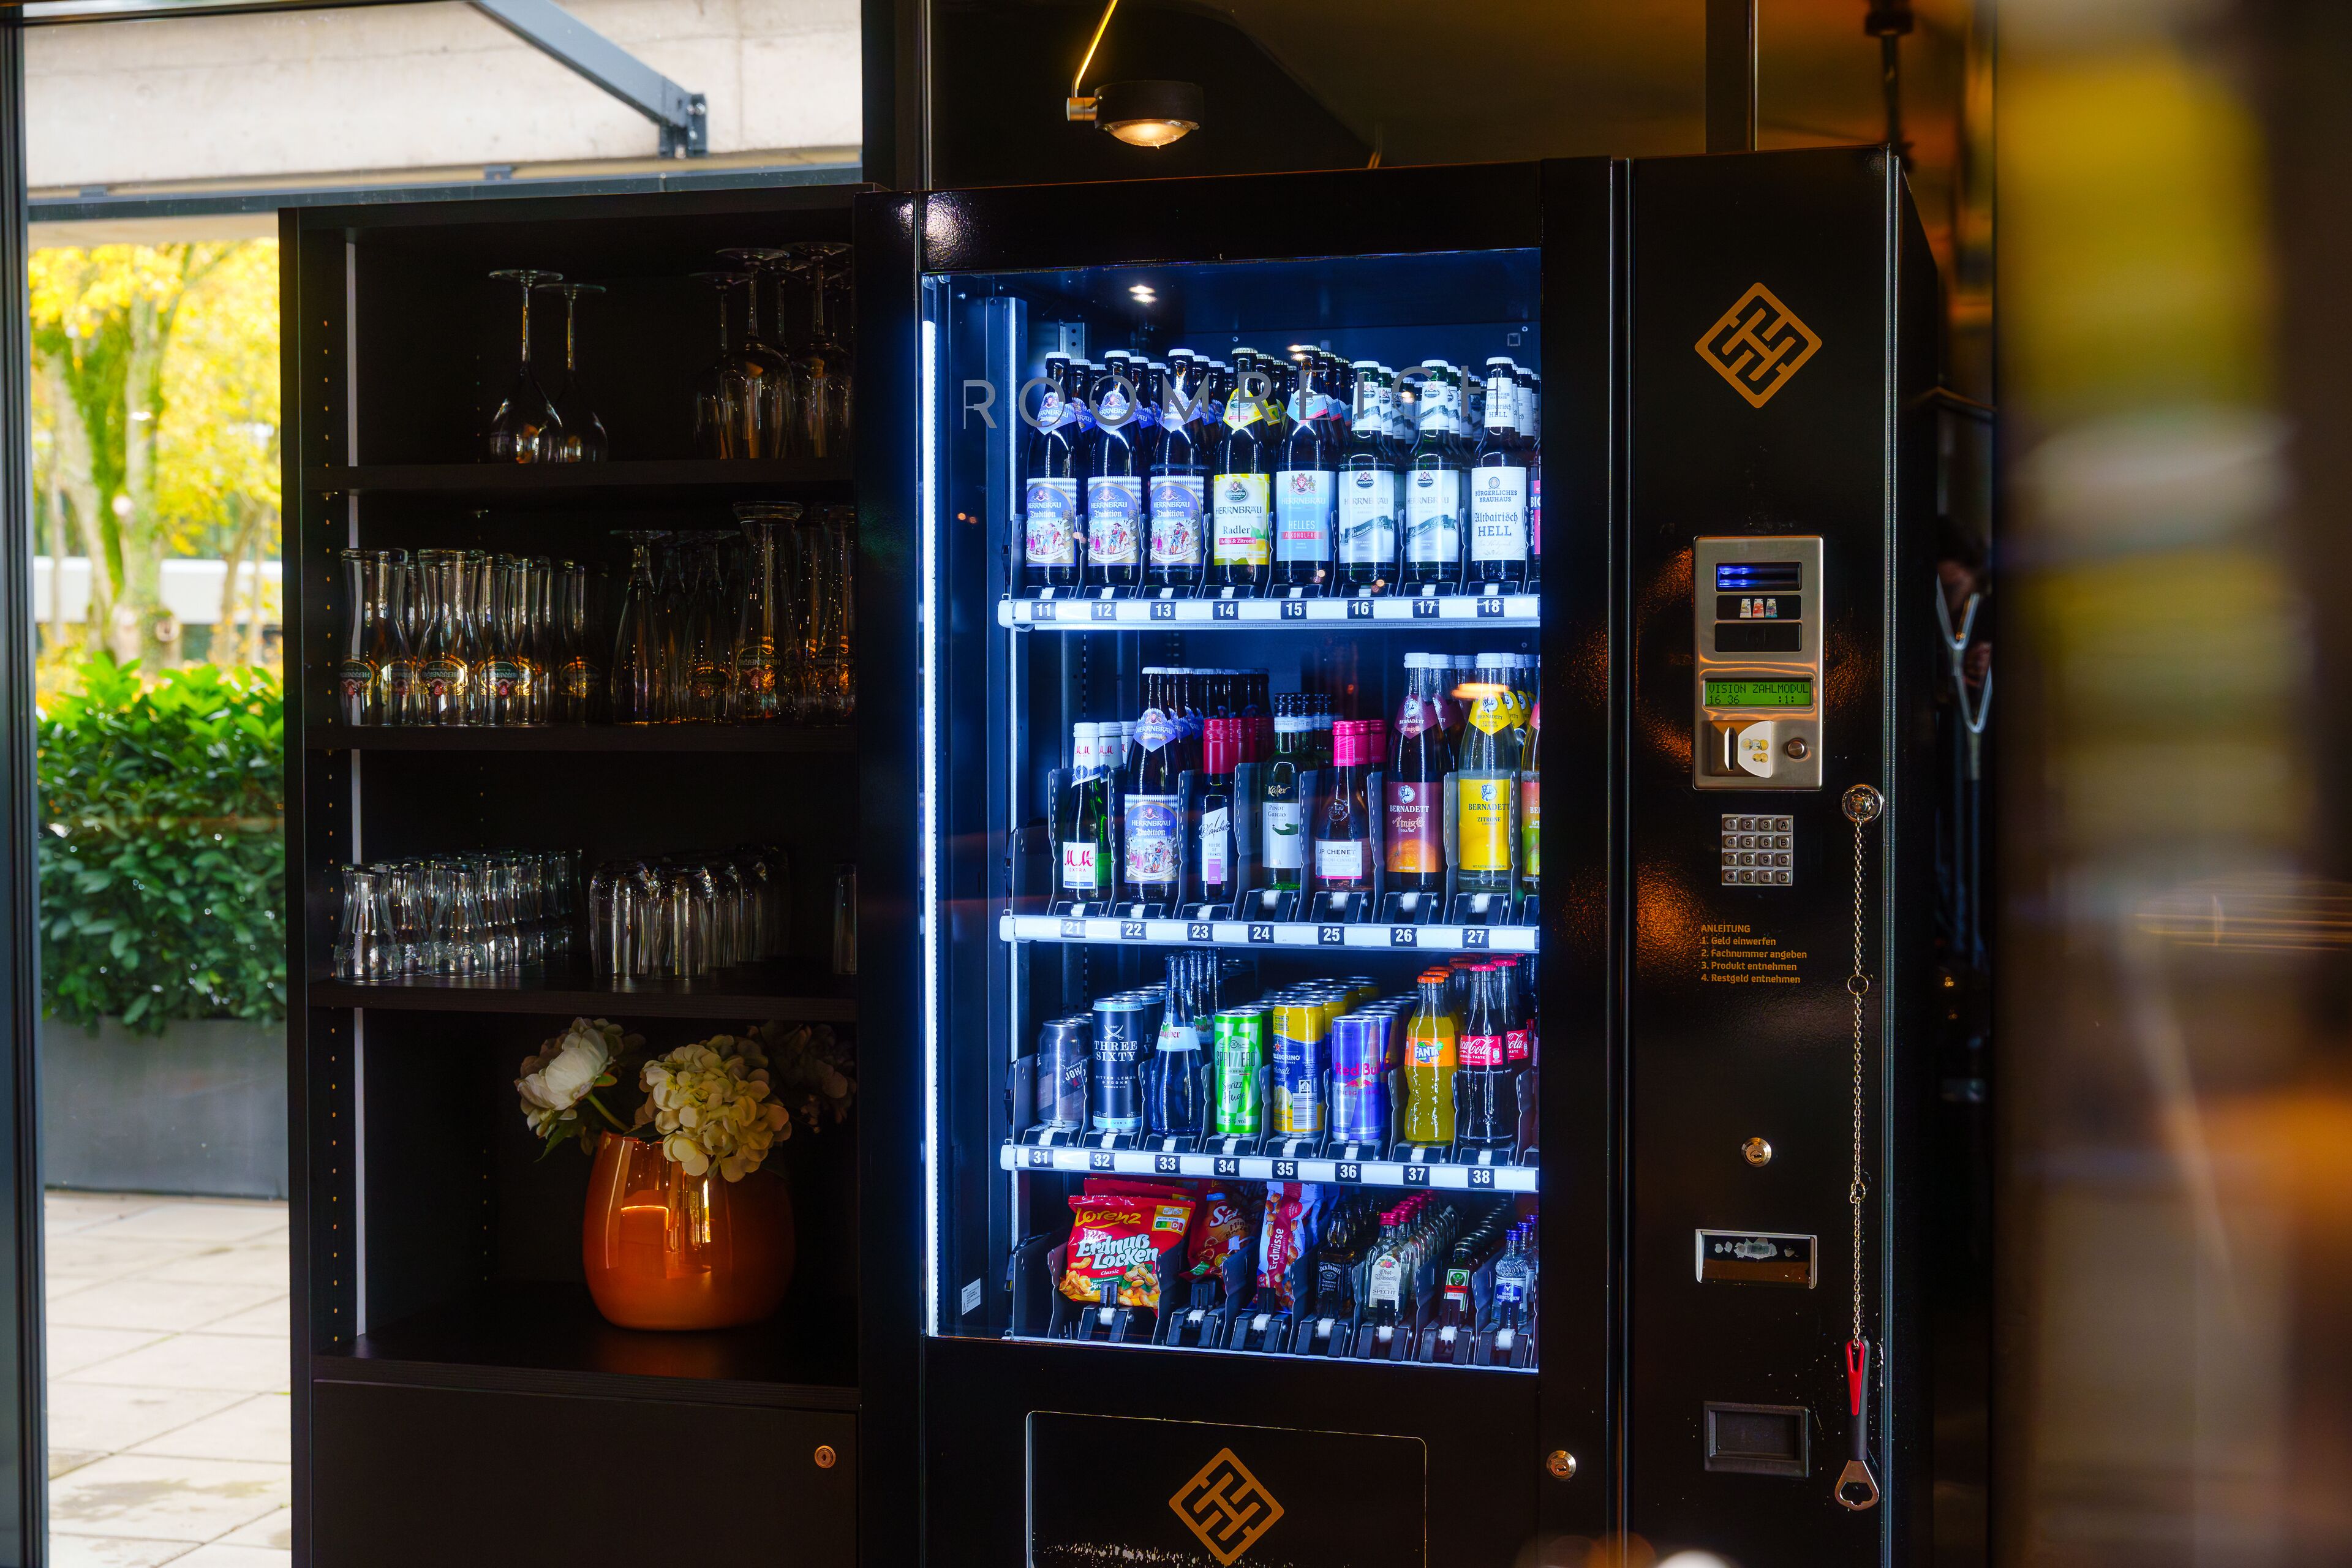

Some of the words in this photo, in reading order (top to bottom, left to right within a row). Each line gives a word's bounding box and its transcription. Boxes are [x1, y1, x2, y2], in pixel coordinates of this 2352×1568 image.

[963, 365, 1499, 429] ROOMREICH
[1093, 510, 1123, 518] Tradition
[1156, 509, 1185, 518] Tradition
[1215, 506, 1262, 515] HERRNBRÄU
[1474, 511, 1518, 525] Altbairisch
[1223, 525, 1251, 535] Radler
[1288, 520, 1315, 530] HELLES
[1347, 525, 1371, 538] Premium
[1477, 526, 1512, 537] HELL
[1036, 604, 1052, 617] 11
[1096, 604, 1112, 617] 12
[1155, 605, 1171, 617] 13
[1218, 604, 1234, 617] 14
[1286, 602, 1302, 616] 15
[1352, 601, 1369, 615] 16
[1418, 600, 1434, 614] 17
[1483, 599, 1499, 613] 18
[1709, 684, 1746, 694] VISION
[1753, 684, 1809, 694] ZAHLMODUL
[1709, 696, 1722, 704] 16
[1727, 696, 1740, 704] 36
[1136, 725, 1172, 734] HERRNBRÄU
[1268, 785, 1291, 797] Käfer
[1135, 827, 1166, 837] Tradition
[1199, 817, 1231, 840] Blanchet
[1065, 921, 1080, 934] 21
[1125, 923, 1142, 936] 22
[1192, 925, 1208, 938] 23
[1253, 927, 1270, 940] 24
[1323, 928, 1340, 941] 25
[1395, 929, 1412, 942] 26
[1467, 930, 1485, 943] 27
[1700, 924, 1751, 933] ANLEITUNG
[1732, 937, 1776, 946] einwerfen
[1770, 951, 1807, 960] angeben
[1711, 962, 1746, 970] Produkt
[1711, 974, 1749, 984] Restgeld
[1751, 974, 1801, 984] entnehmen
[1094, 1040, 1137, 1051] THREE
[1096, 1051, 1136, 1061] SIXTY
[1414, 1046, 1440, 1058] FANTA
[1335, 1061, 1360, 1076] Red
[1222, 1080, 1243, 1091] Sprizz
[1224, 1091, 1246, 1107] Hugo
[1033, 1150, 1049, 1164] 31
[1094, 1154, 1110, 1167] 32
[1159, 1156, 1175, 1170] 33
[1218, 1159, 1235, 1174] 34
[1276, 1162, 1294, 1176] 35
[1340, 1164, 1357, 1178] 36
[1408, 1167, 1425, 1182] 37
[1472, 1169, 1490, 1184] 38
[1075, 1207, 1142, 1229] Lorenz
[1076, 1234, 1150, 1257] Erdnuß
[1269, 1228, 1284, 1270] Erdnüsse
[1091, 1247, 1159, 1269] Locken
